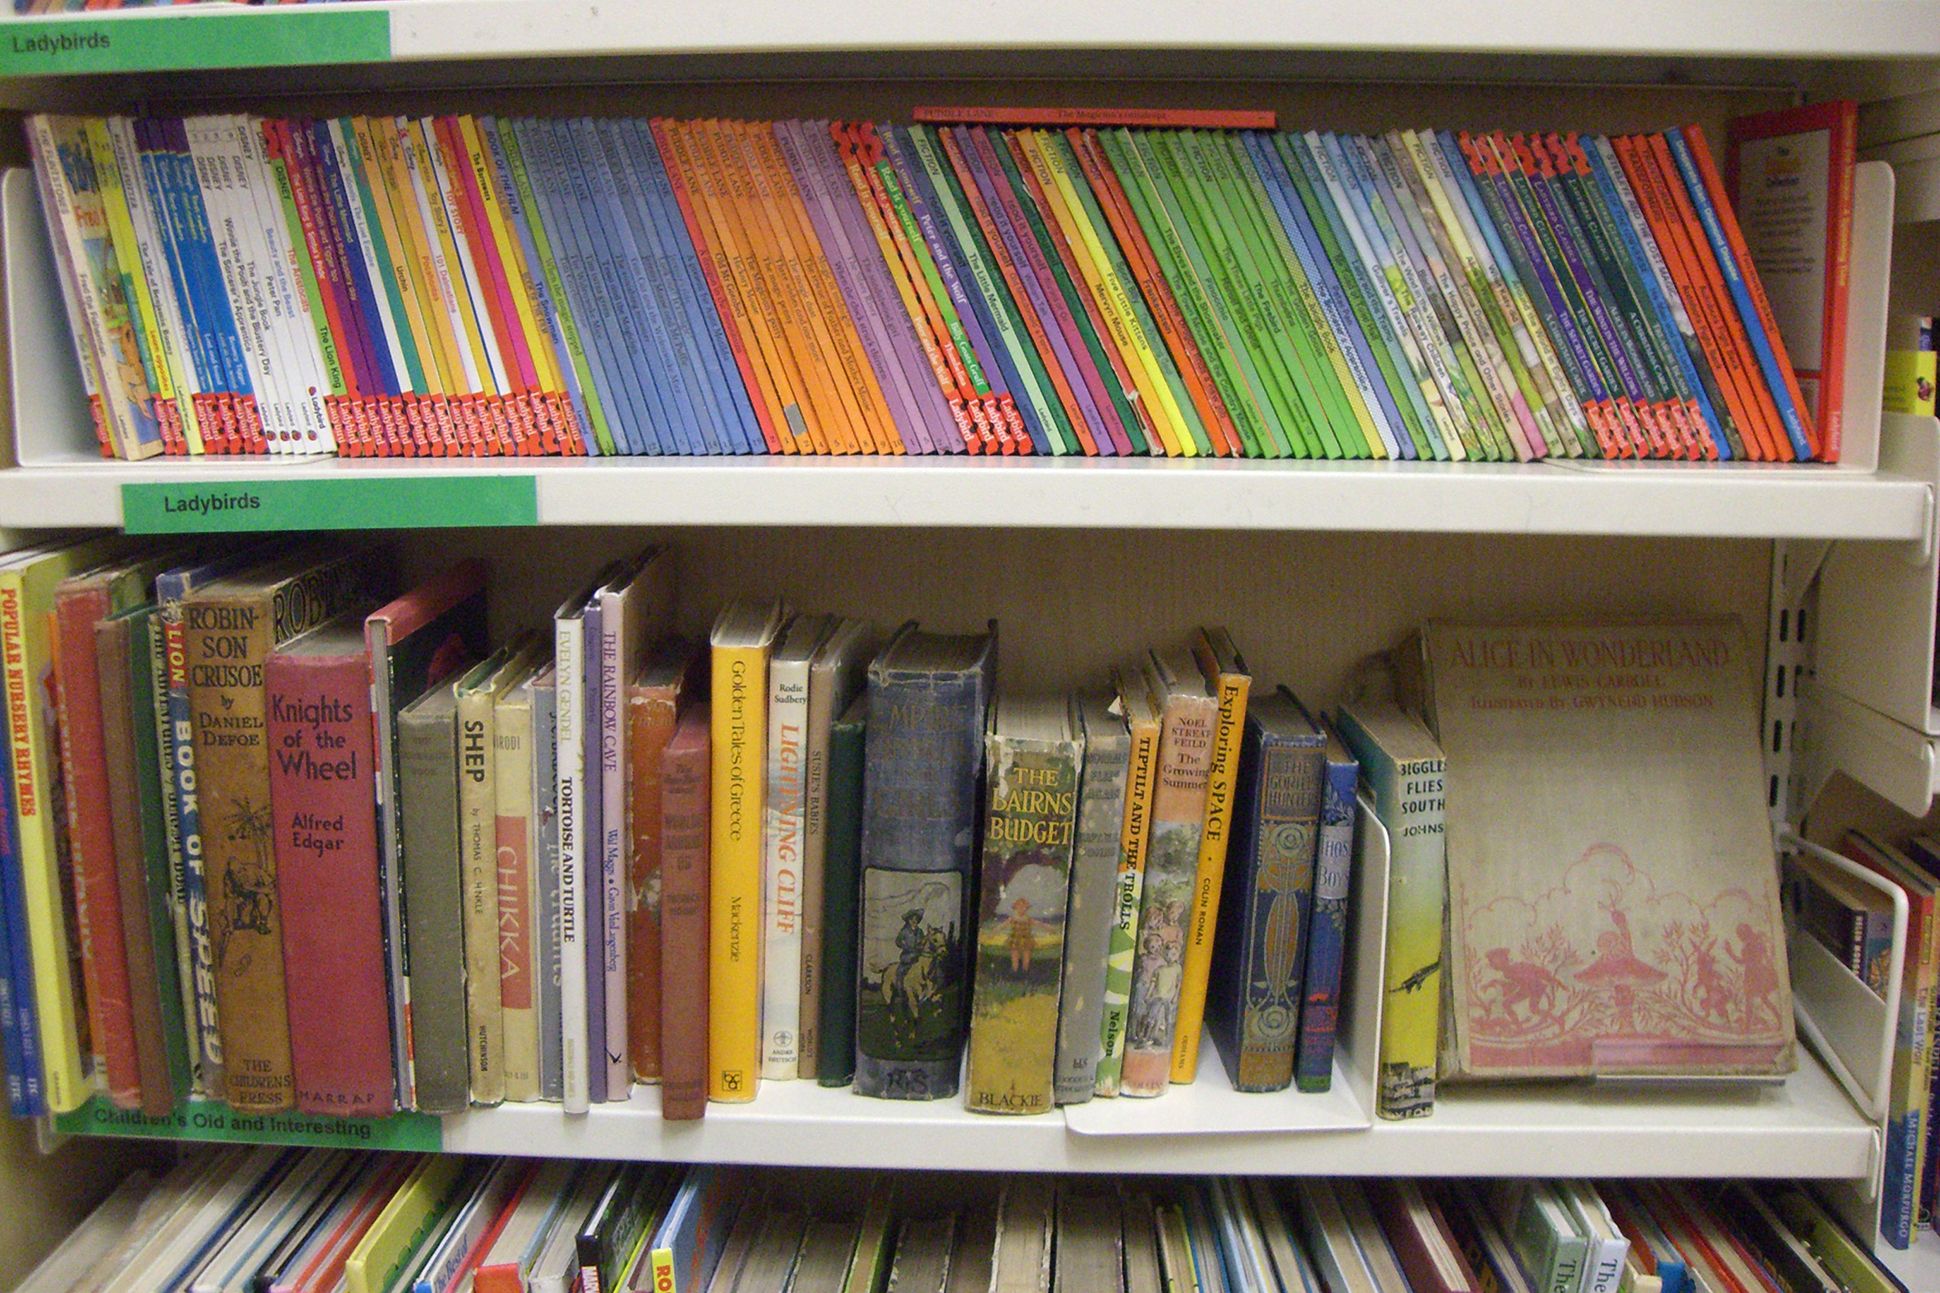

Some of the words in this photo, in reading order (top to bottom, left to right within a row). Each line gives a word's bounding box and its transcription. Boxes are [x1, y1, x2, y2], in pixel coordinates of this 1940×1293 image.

[13, 33, 110, 54] Ladybirds
[917, 138, 939, 177] FICTION
[1029, 148, 1053, 186] FICTION
[1041, 135, 1064, 175] FICTION
[1412, 141, 1434, 179] FICTION
[1429, 141, 1451, 178] FICTION
[218, 241, 228, 257] The
[920, 214, 938, 240] Peter
[932, 241, 947, 260] and
[942, 262, 955, 279] the
[950, 281, 966, 303] Wolf
[222, 259, 241, 303] Sorcerer's
[246, 261, 257, 276] The
[394, 265, 410, 291] Urchin
[223, 217, 238, 246] Winnie
[236, 265, 248, 286] Pooh
[250, 321, 268, 356] Blustery
[260, 358, 272, 376] Day
[249, 278, 265, 307] Jungle
[264, 275, 278, 297] Peter
[272, 299, 284, 316] Pan
[968, 253, 981, 269] The
[976, 270, 991, 292] Little
[987, 293, 1008, 331] Mermaid
[1106, 272, 1119, 291] Five
[1116, 292, 1132, 316] Little
[1129, 317, 1147, 350] Kittens
[234, 305, 253, 352] Apprentice
[259, 308, 272, 330] Book
[534, 281, 545, 297] The
[540, 299, 560, 343] Snowman
[1094, 283, 1114, 316] Mervyn
[1111, 316, 1129, 346] Mouse
[319, 326, 330, 343] The
[948, 321, 964, 340] Billy
[958, 340, 975, 363] Goats
[968, 363, 984, 386] Gruff
[324, 345, 336, 364] Lion
[329, 367, 342, 388] King
[195, 399, 213, 441] Ladybird
[243, 400, 263, 442] Ladybird
[311, 396, 327, 430] Ladybird
[327, 401, 345, 443] Ladybird
[339, 401, 357, 444] Ladybird
[407, 401, 428, 444] Ladybird
[531, 391, 551, 432] Ladybird
[951, 399, 974, 442] Ladybird
[970, 398, 995, 442] Ladybird
[985, 398, 1010, 442] Ladybird
[1000, 397, 1027, 442] Ladybird
[163, 492, 261, 516] Ladybirds
[1, 588, 22, 666] POPULAR
[188, 606, 259, 631] ROBIN-
[168, 630, 186, 684] LION
[202, 636, 248, 659] SON
[557, 630, 571, 686] EVELYN
[603, 631, 617, 665] THE
[1559, 639, 1732, 668] WONDERLAND
[191, 664, 263, 688] CRUSOE
[730, 659, 747, 720] Golden
[779, 683, 804, 693] Rodie
[7, 668, 29, 744] NURSERY
[221, 695, 235, 710] by
[272, 694, 353, 730] Knights
[558, 688, 572, 744] GENDEL
[602, 667, 617, 734] RAINBOW
[774, 694, 808, 706] Sudbery
[200, 712, 264, 729] DANIEL
[202, 730, 260, 748] DEFOE
[1178, 716, 1208, 728] NOEL
[1210, 685, 1239, 774] Exploring
[283, 731, 303, 748] of
[317, 731, 346, 749] the
[464, 720, 486, 783] SHEP
[603, 736, 617, 773] CAVE
[730, 721, 745, 764] Tales
[1178, 752, 1200, 764] The
[175, 720, 199, 816] BOOK
[277, 750, 357, 781] Wheel
[729, 765, 745, 781] of
[810, 750, 821, 793] SUSIE'S
[1014, 767, 1059, 786] THE
[1132, 737, 1150, 800] TIPTILT
[1163, 765, 1211, 780] Growing
[1163, 777, 1207, 791] Summer
[776, 723, 800, 862] LIGHTNING
[1406, 779, 1444, 795] FLIES
[291, 814, 344, 831] Alfred
[560, 776, 574, 851] TORTOISE
[728, 782, 744, 841] Greece
[808, 797, 820, 835] BABIES
[1128, 803, 1143, 835] AND
[1206, 780, 1228, 842] SPACE
[1401, 799, 1446, 815] SOUTH
[293, 831, 345, 857] Edgar
[472, 823, 482, 861] THOMAS
[990, 817, 1074, 845] BUDGET
[1403, 823, 1444, 837] JOHNS
[186, 834, 205, 877] OF
[562, 854, 575, 886] AND
[1125, 838, 1140, 870] THE
[497, 846, 521, 981] CHIKKA
[563, 888, 576, 943] TURTLE
[776, 868, 797, 936] CLIFF
[1120, 872, 1135, 931] TROLLS
[1200, 878, 1211, 915] COLIN
[730, 896, 742, 962] Mackenzie
[1195, 916, 1209, 946] RONAN
[189, 893, 224, 1065] SPEED
[1105, 1010, 1121, 1057] Nelson
[299, 1090, 376, 1105] HARRAP
[979, 1091, 1044, 1107] BLACKIE
[95, 1108, 187, 1128] Children's
[193, 1113, 225, 1130] Old
[230, 1115, 265, 1132] and
[270, 1117, 372, 1139] Interesting
[1904, 1117, 1918, 1169] MICHAEL
[1898, 1173, 1914, 1238] MORPURGO
[656, 1264, 673, 1292] RO
